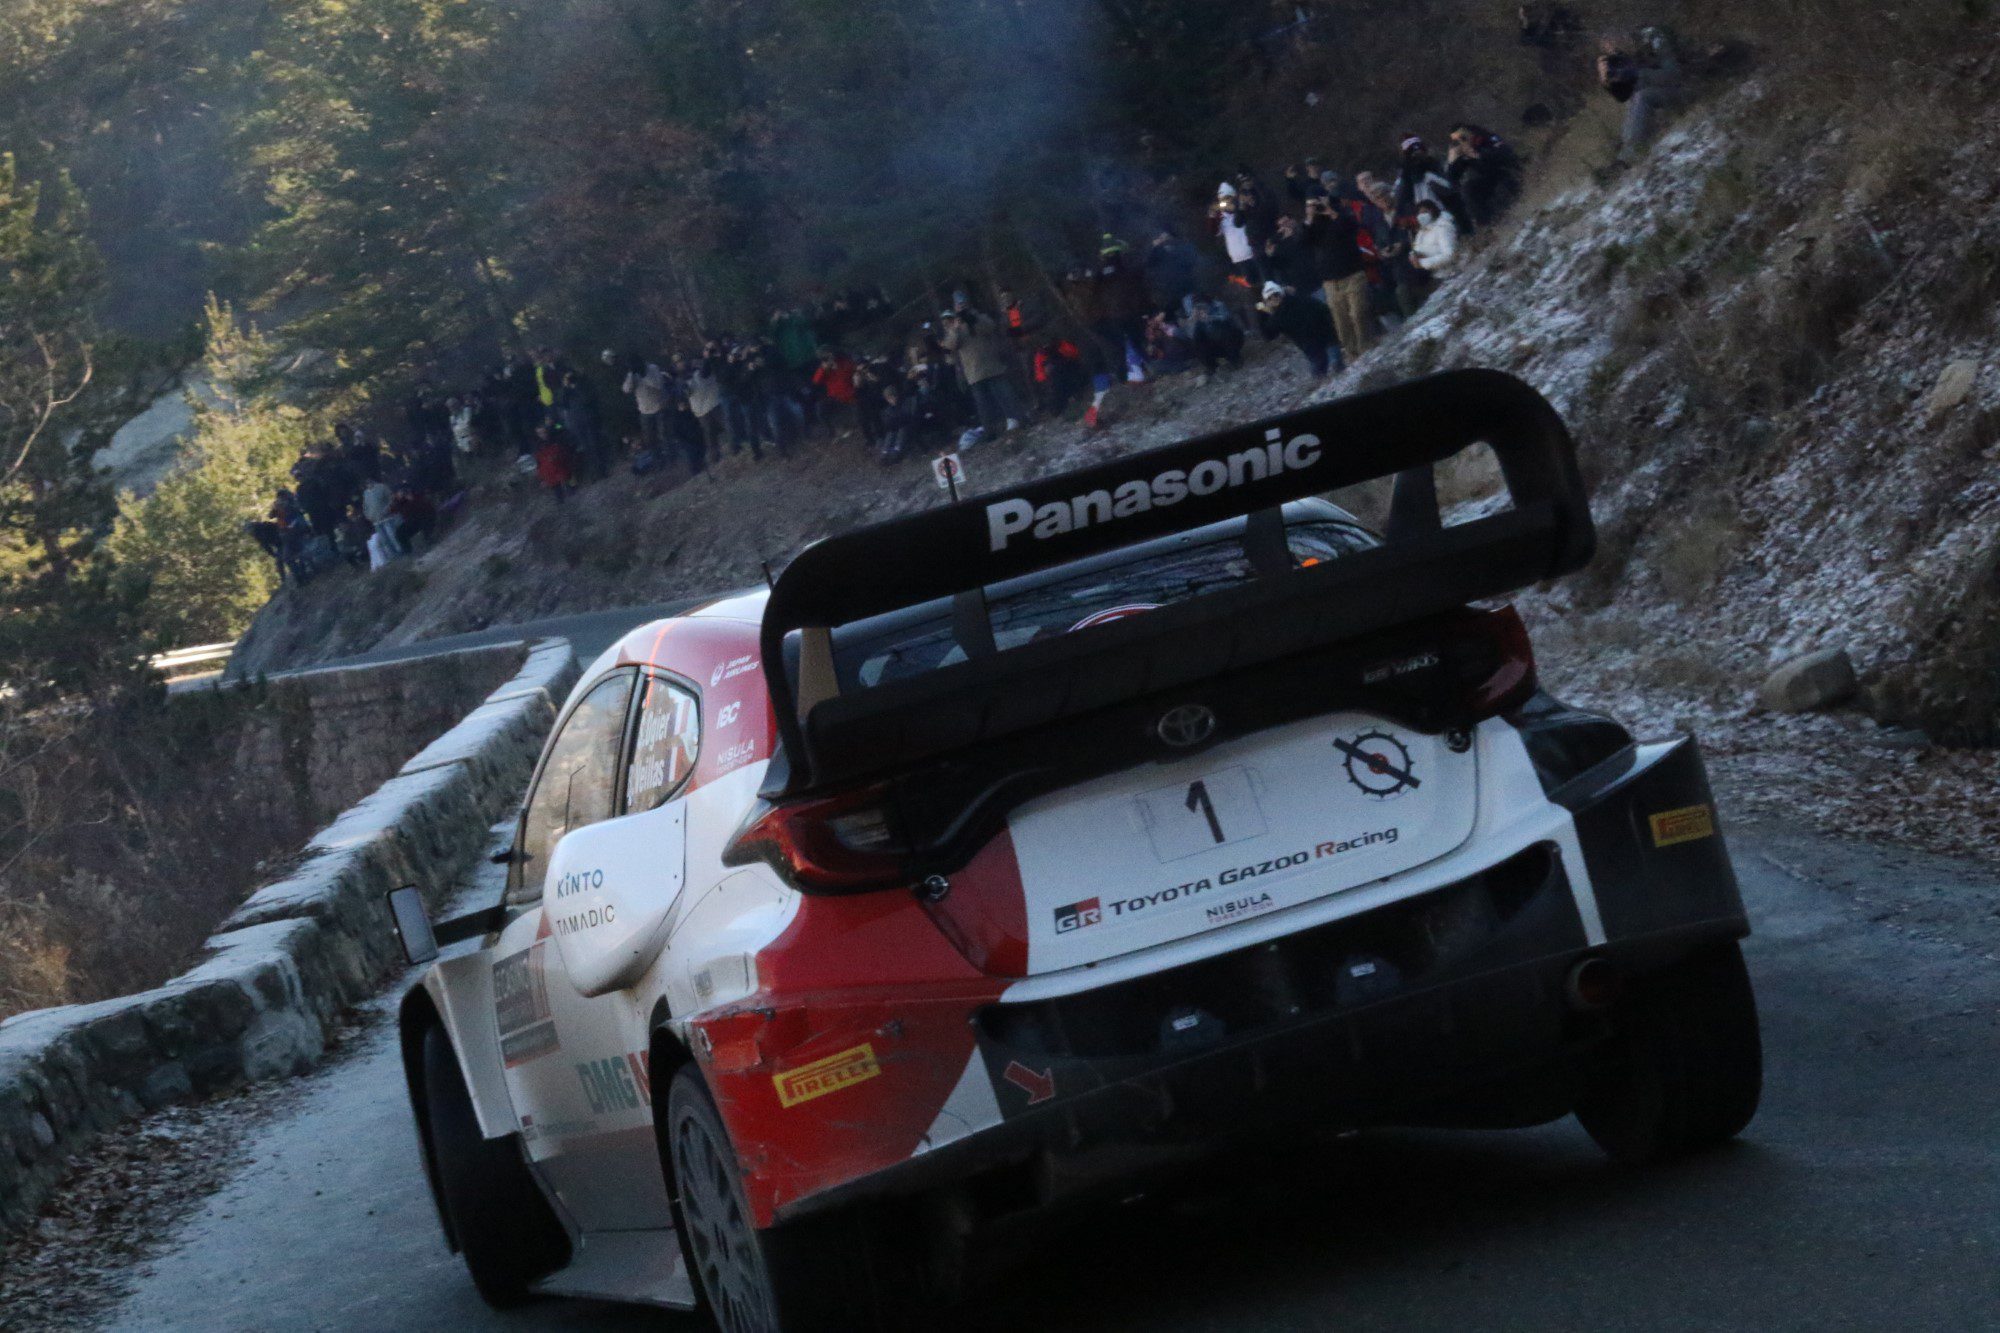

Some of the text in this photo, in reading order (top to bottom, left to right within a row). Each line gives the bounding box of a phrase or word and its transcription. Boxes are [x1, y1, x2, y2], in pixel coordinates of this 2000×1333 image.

[985, 427, 1322, 552] Panasonic
[716, 738, 755, 766] NISULA
[1184, 780, 1225, 843] 1
[1055, 826, 1400, 934] GR TOYOTA GAZOO Racing
[1206, 892, 1271, 918] NISULA
[556, 905, 615, 936] TAMADIC
[576, 1056, 640, 1115] DMG
[781, 1050, 872, 1098] PIRELLI
